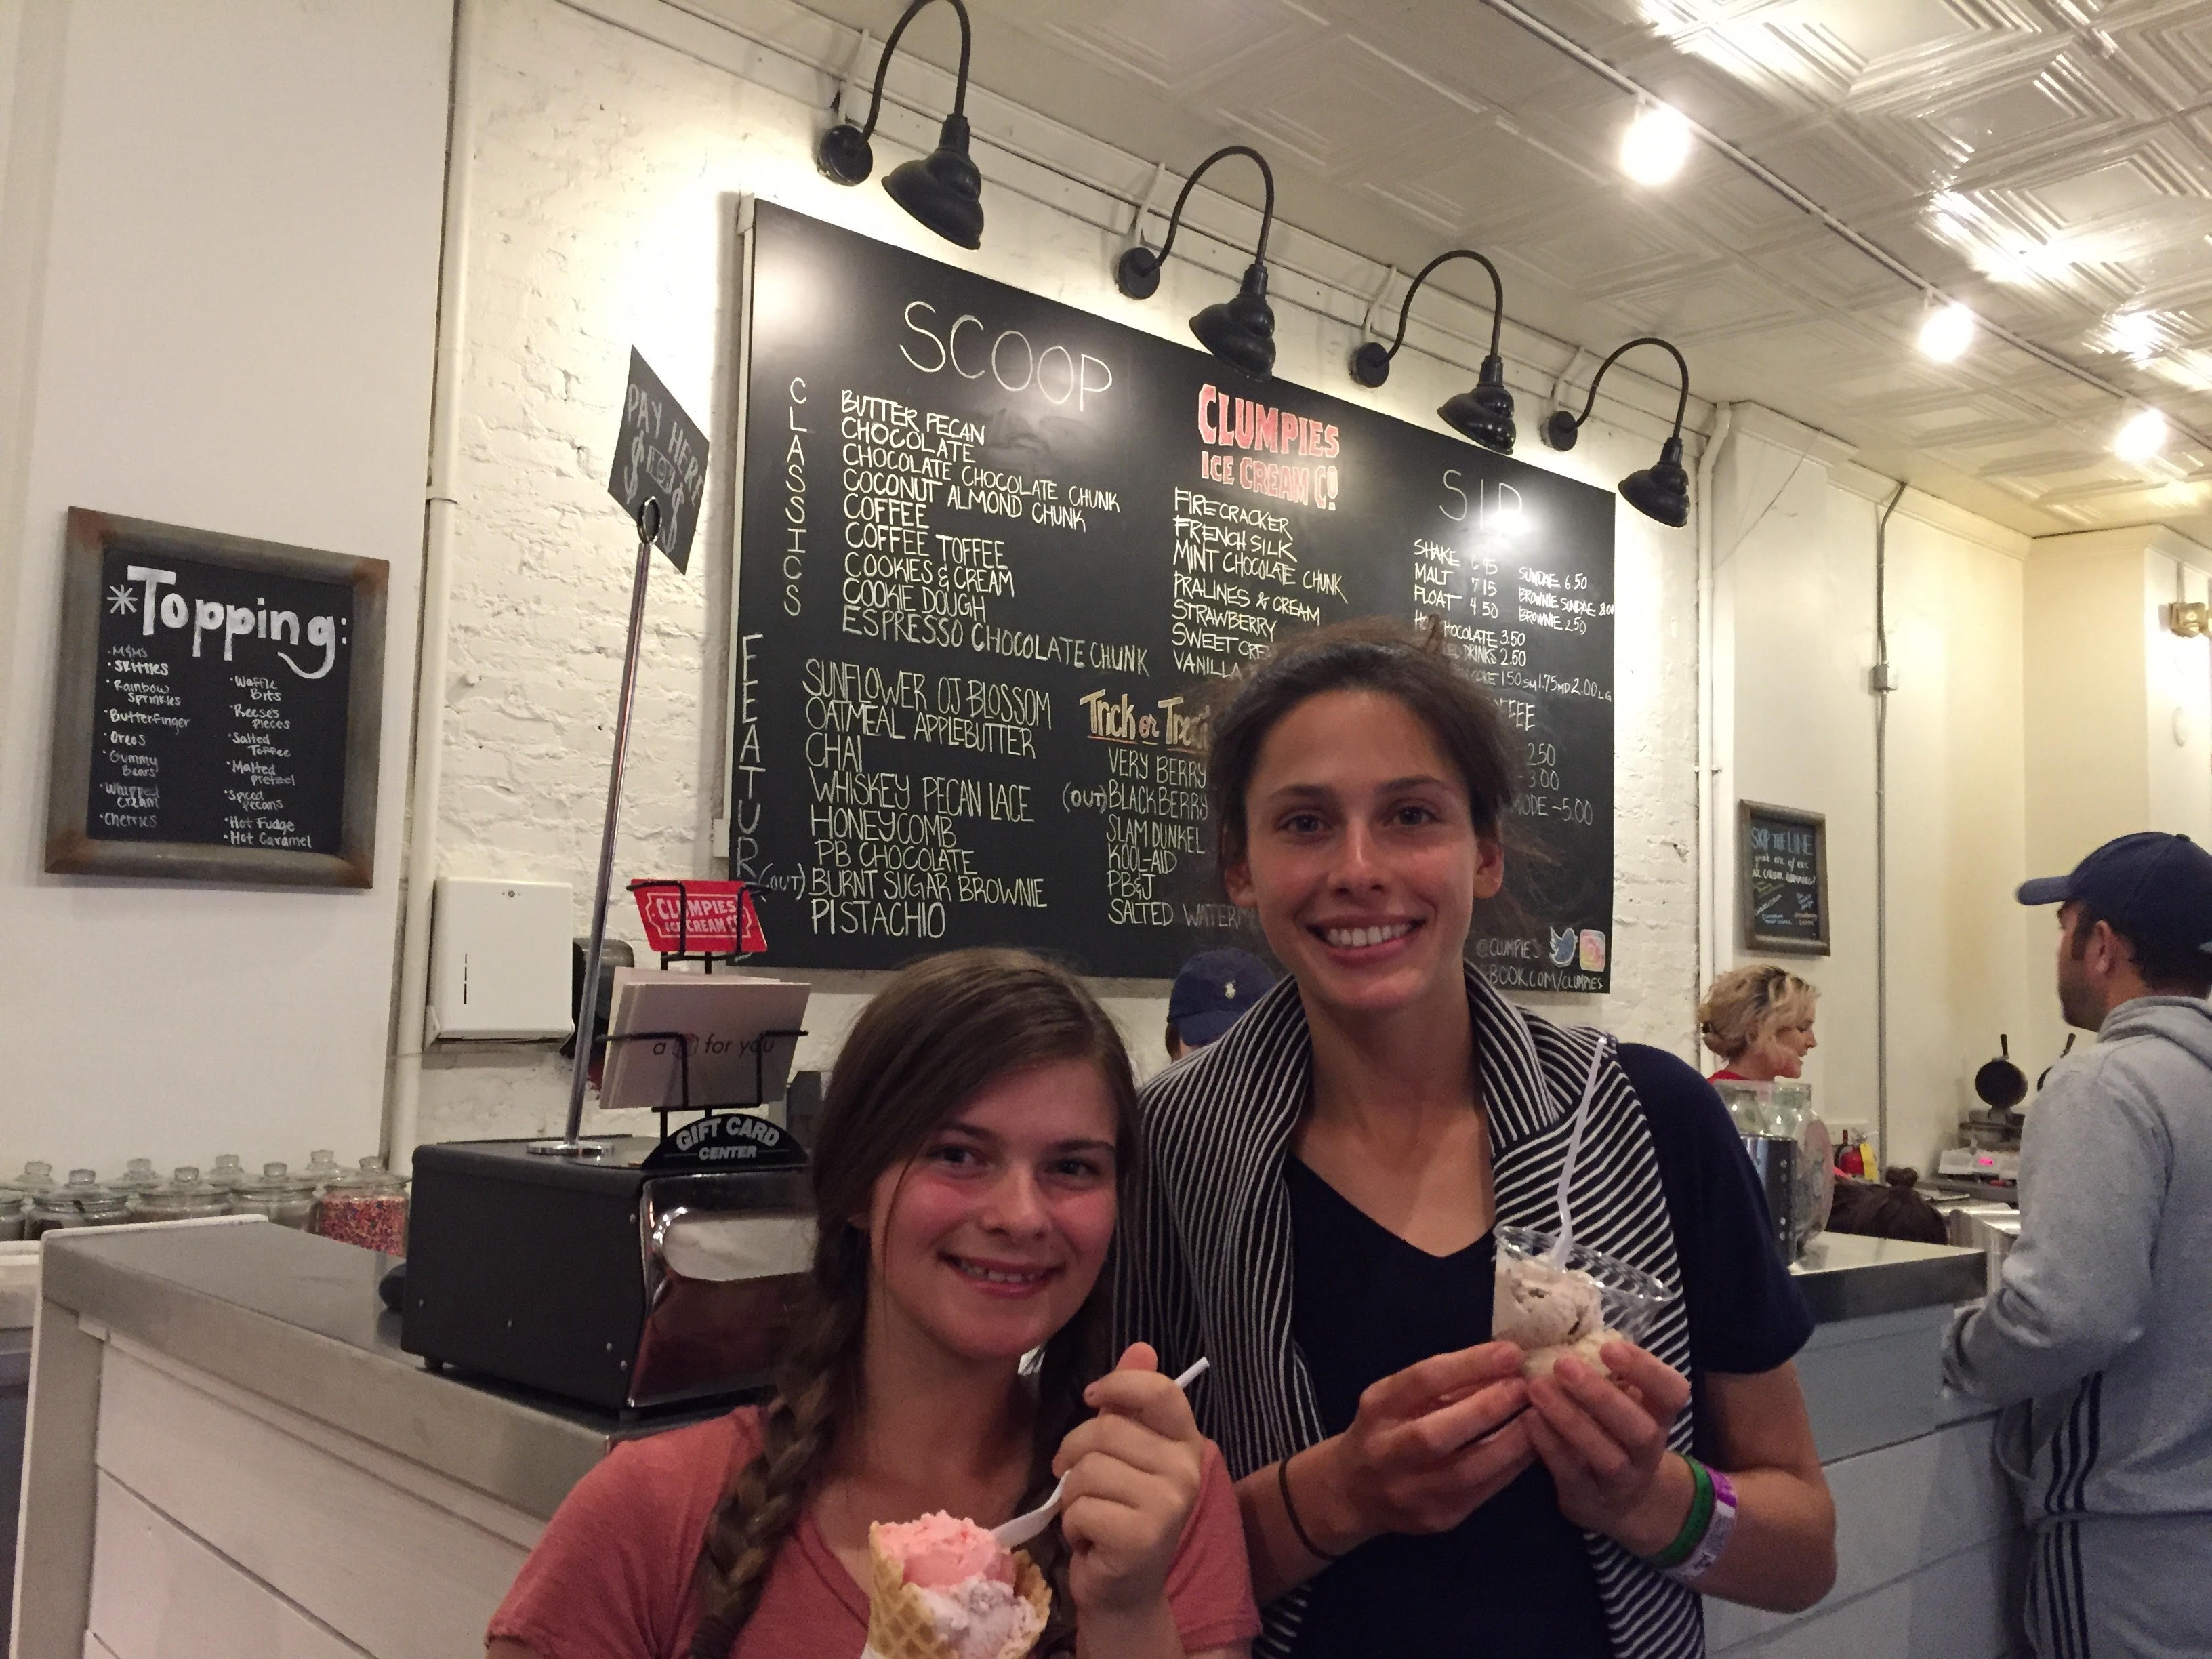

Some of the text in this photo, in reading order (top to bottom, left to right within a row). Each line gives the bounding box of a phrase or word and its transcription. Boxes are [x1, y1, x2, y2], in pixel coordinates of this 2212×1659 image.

[900, 301, 1113, 411] SCOOP
[842, 390, 985, 445] BUTTER PECAN
[1199, 383, 1339, 458] CLUMPIES
[627, 383, 704, 506] PAY HERE
[842, 416, 976, 463] CHOCOLATE
[843, 443, 1120, 513] CHOCOLATE CHOCOLATE CHUNK
[1202, 451, 1234, 485] ICE
[1240, 457, 1309, 506] CREAM
[783, 377, 808, 616] CLASSICS
[843, 468, 1086, 532] COCONUT ALMOND CHUNK
[843, 494, 930, 529] COFFEE
[1174, 486, 1293, 541] FIRECRACKER
[845, 522, 1009, 570] COFFEE TOFFEE
[1173, 515, 1298, 563] FRENCH SILK
[1414, 539, 1460, 566] SHAKE
[844, 552, 1015, 597] COOKIES & CREAM
[1173, 539, 1349, 605] MINT CHOCOLATE CHUNK
[1414, 562, 1454, 585] MALT
[1519, 567, 1561, 588] SUNDAE
[843, 579, 987, 623] COOKIE DOUGH
[1174, 571, 1321, 626] PRALINES & CREAM
[1414, 583, 1462, 611] FLOAT
[1519, 586, 1559, 608] BROWNIE
[1560, 597, 1596, 617] SUNDAE
[1172, 599, 1277, 642] STRAWBERRY
[1441, 620, 1498, 649] HOCOLATE
[1500, 630, 1525, 647] 3.50
[1519, 605, 1563, 630] BROWNIE
[843, 605, 1150, 676] ESPRESSO CHOCOLATE CHUNK
[1172, 621, 1270, 661] SWEET CRE
[1463, 644, 1497, 665] DRINKS
[1500, 647, 1526, 666] 2.50
[1173, 649, 1242, 679] VANILLA
[113, 679, 169, 694] Rainbow
[234, 676, 278, 690] Waffle
[250, 688, 282, 701] Bits
[803, 659, 927, 712] SUNFLOWER
[967, 680, 1052, 730] BLOSSOM
[110, 708, 190, 735] Butterfinger
[806, 697, 1036, 759] OATMEAL APPLEBUTTER
[1079, 689, 1136, 740] Trick
[110, 731, 146, 746] Oreos
[232, 732, 270, 745] Salted
[247, 745, 291, 758] Toffee
[806, 733, 863, 773] CHAI
[109, 750, 159, 772] Gummy
[122, 765, 157, 777] Bears
[232, 760, 276, 776] Malted
[1108, 747, 1207, 789] VERY BERRY
[810, 768, 1036, 823] WHISKEY PECAN LACE
[1519, 794, 1549, 816] ODE
[104, 813, 157, 828] Cherries
[230, 815, 295, 835] Hot Fudge
[811, 804, 957, 848] HONEYCOMB
[1106, 814, 1206, 855] SLAM DUNKEL
[230, 831, 312, 848] Hot Caramel
[815, 838, 978, 875] PB CHOCOLATE
[1108, 843, 1177, 874] KOOL-AID
[808, 867, 877, 899] BURNT
[884, 871, 953, 902] SUGAR
[958, 878, 1048, 908] BROWNIE
[1107, 869, 1156, 900] PB&J
[686, 918, 726, 933] CREAM
[811, 899, 946, 938] PISTACHIO
[1108, 898, 1174, 926] SALTED
[653, 1042, 667, 1055] a
[705, 1033, 733, 1054] for
[676, 1116, 779, 1151] GIFT CARD
[699, 1145, 758, 1160] CENTER
